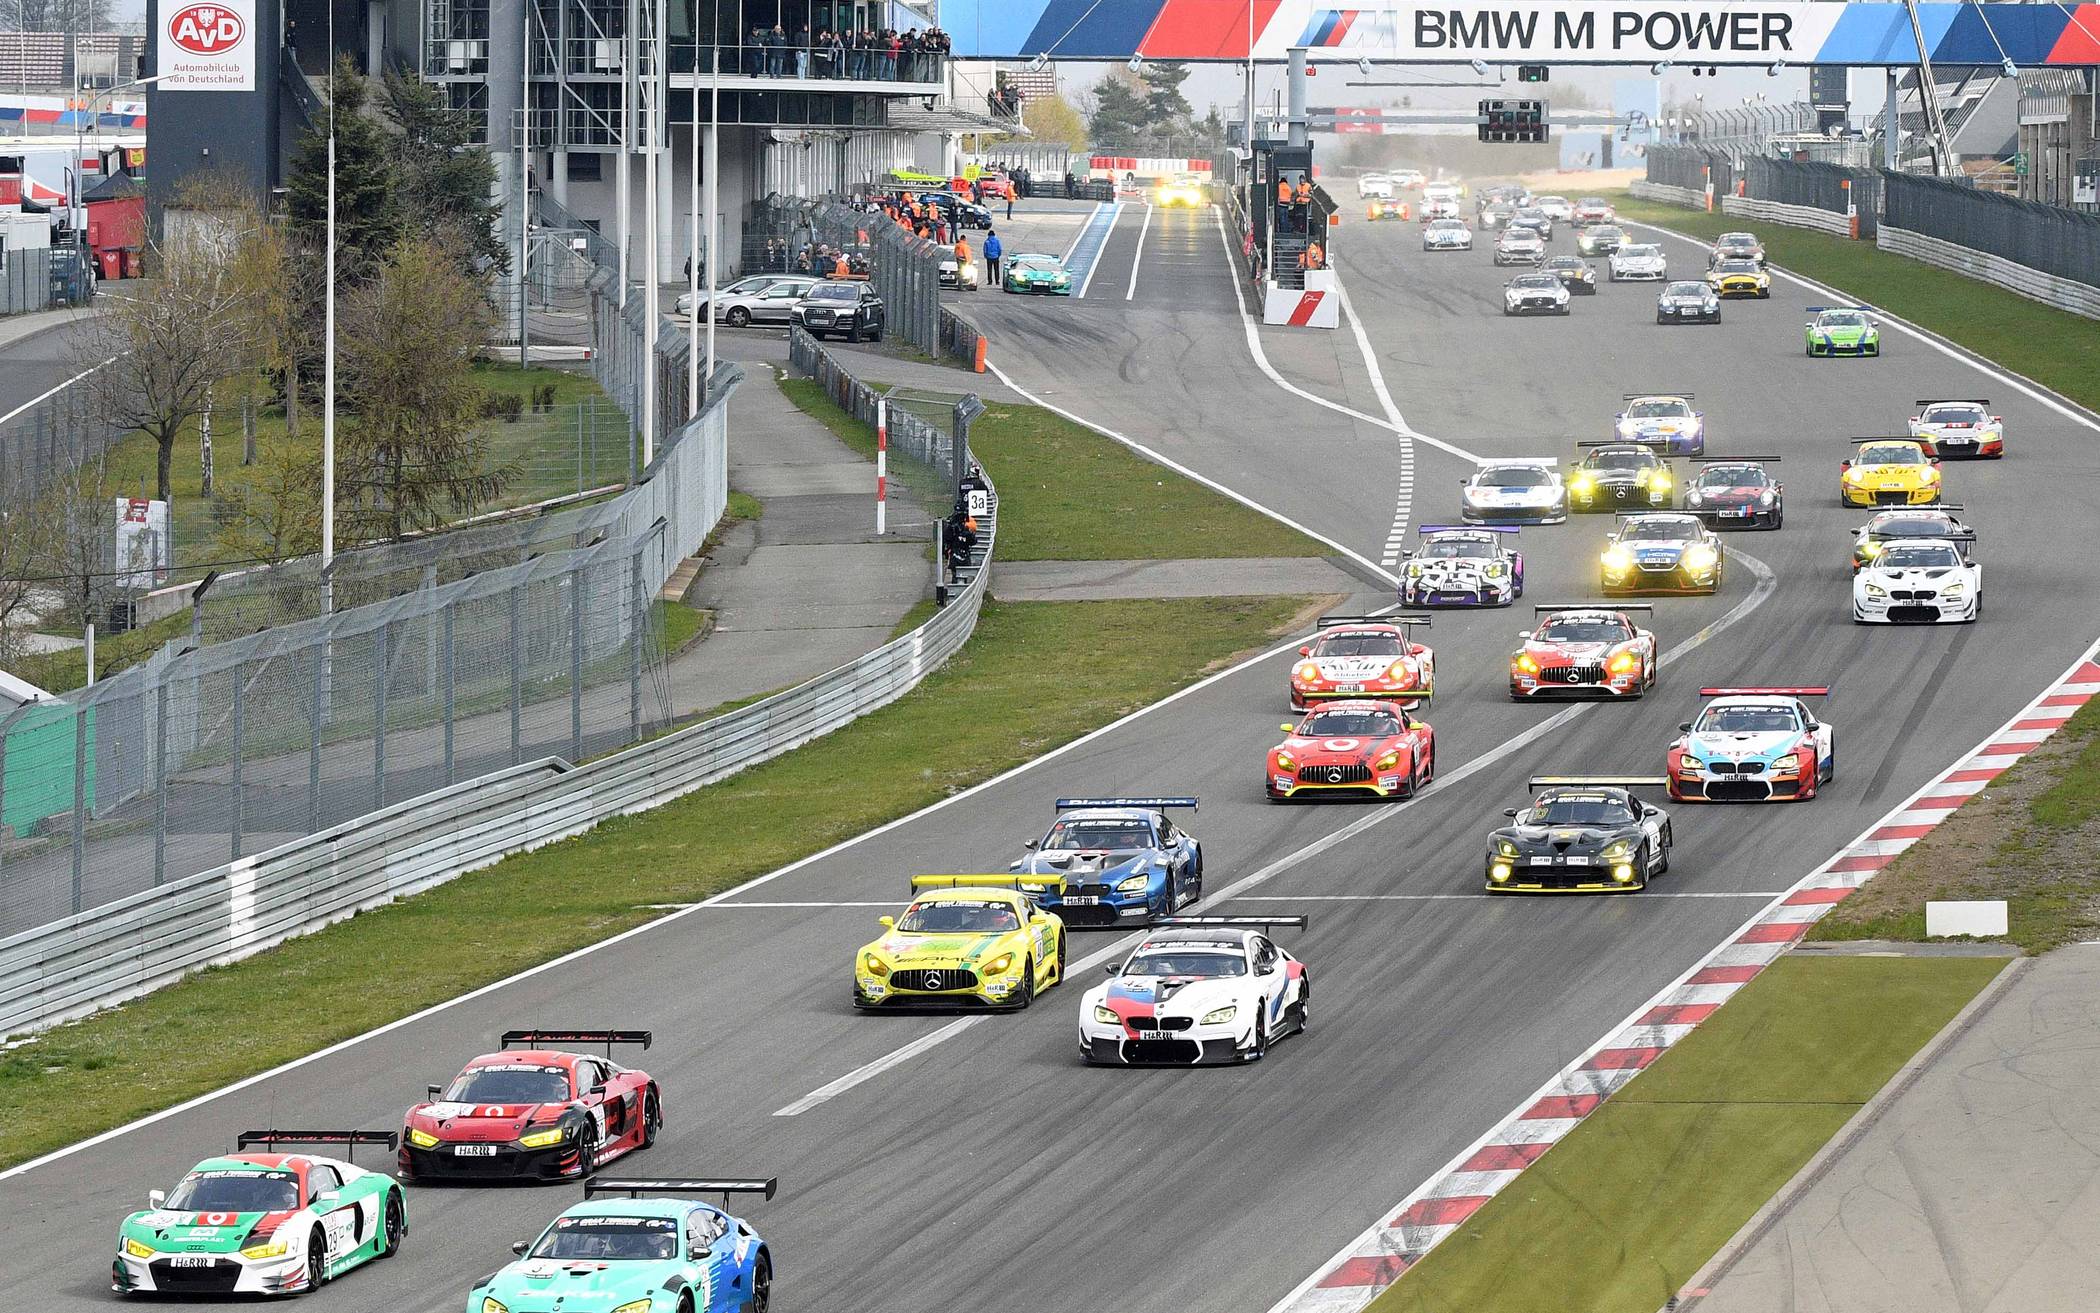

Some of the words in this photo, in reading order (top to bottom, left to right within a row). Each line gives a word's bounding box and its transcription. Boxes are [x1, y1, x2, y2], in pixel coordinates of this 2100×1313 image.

[1415, 10, 1539, 49] BMW
[1554, 11, 1594, 49] M
[1612, 11, 1793, 51] POWER
[173, 63, 240, 72] Automobilclub
[188, 74, 244, 83] Deutschland
[971, 494, 985, 510] 3a
[328, 1231, 338, 1253] 29
